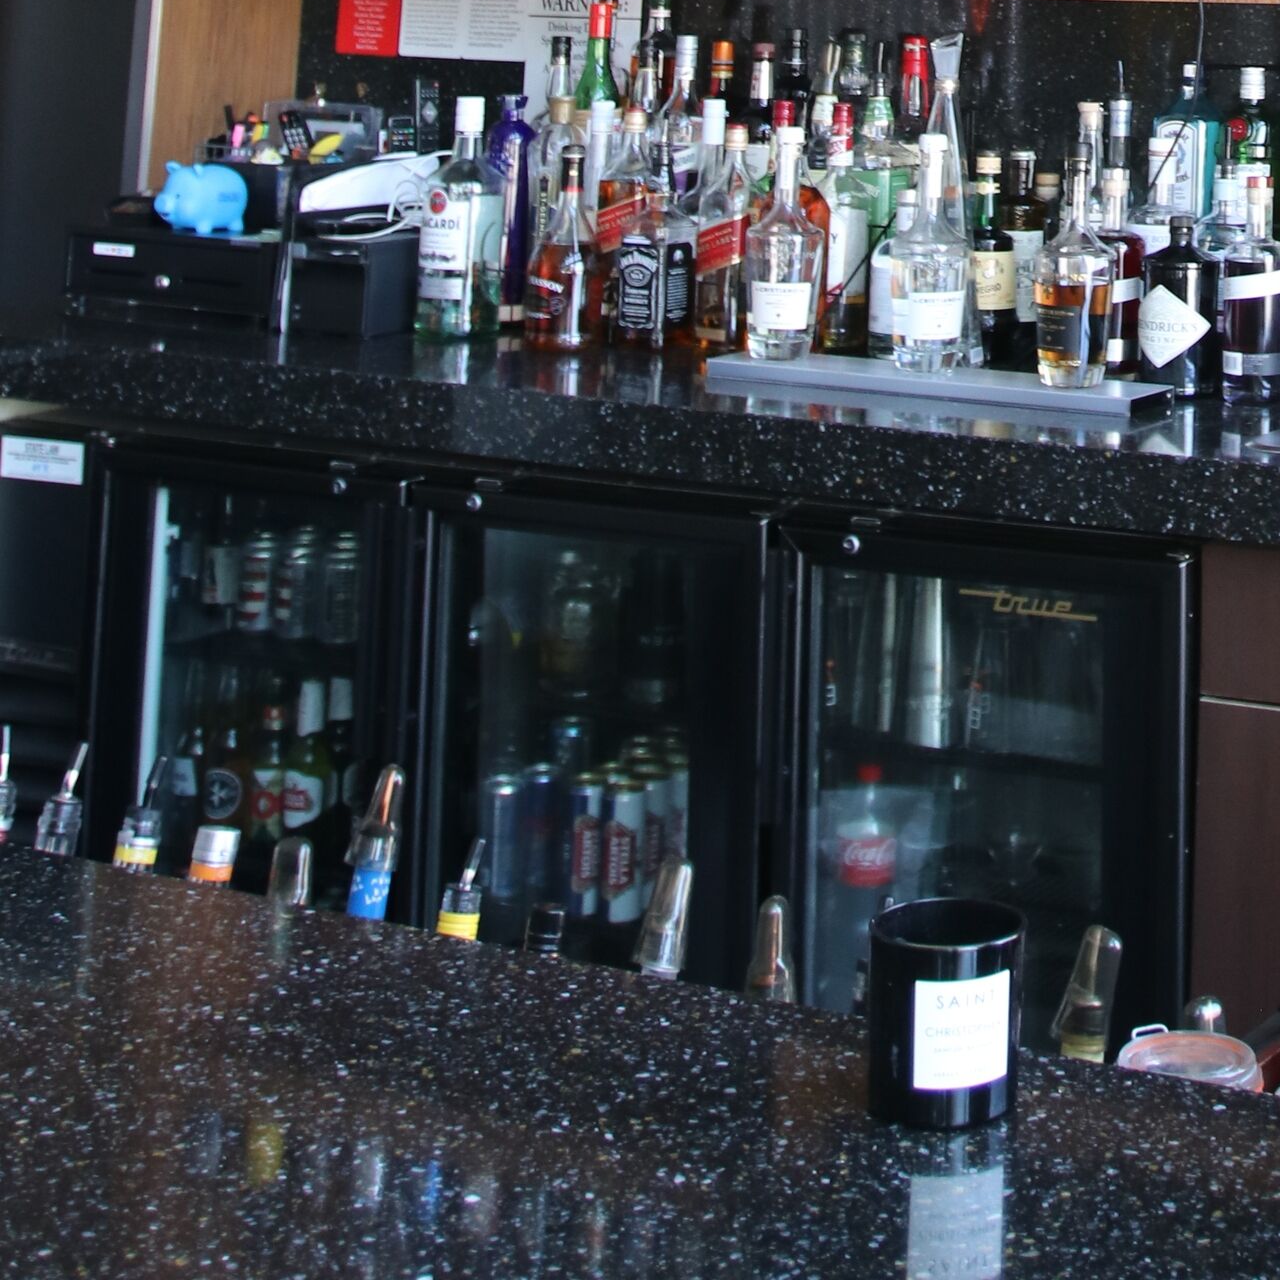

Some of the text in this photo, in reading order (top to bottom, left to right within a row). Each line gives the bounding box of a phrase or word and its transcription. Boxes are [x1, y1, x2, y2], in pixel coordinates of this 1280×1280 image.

[547, 21, 582, 33] Drinking
[1138, 319, 1198, 333] ENDRICK'S
[993, 590, 1073, 614] true
